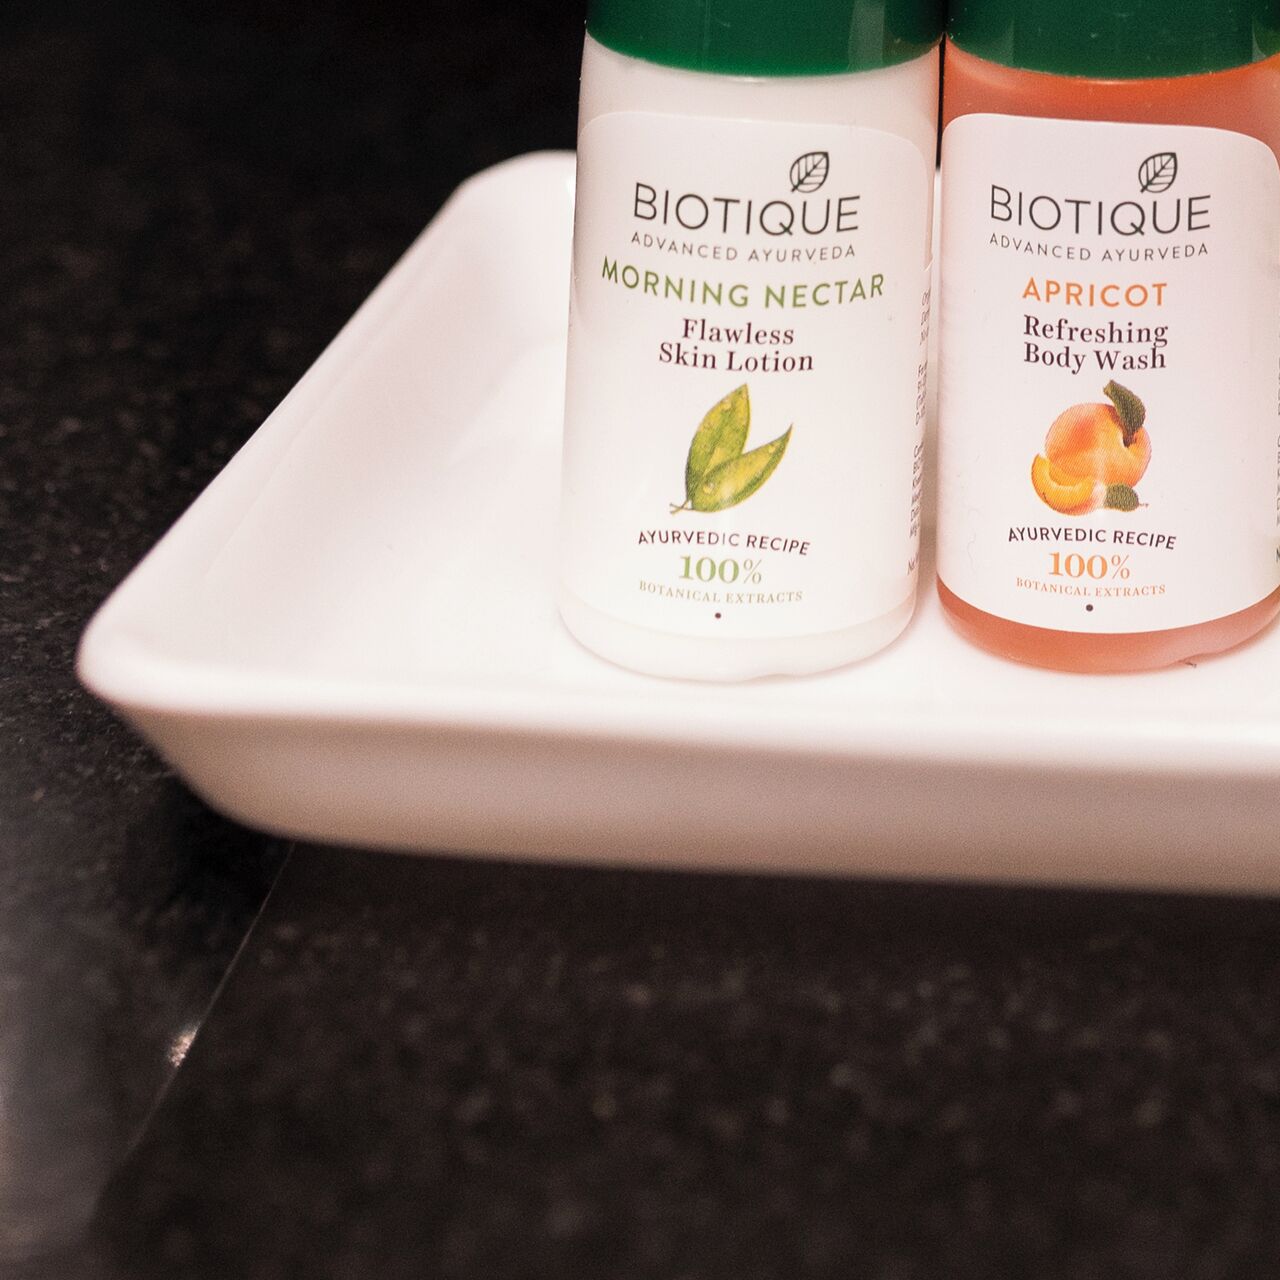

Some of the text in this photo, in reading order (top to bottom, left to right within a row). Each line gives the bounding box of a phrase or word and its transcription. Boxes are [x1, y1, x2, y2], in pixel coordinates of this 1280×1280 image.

[633, 182, 861, 237] BIOTIQUE
[990, 184, 1212, 237] BIOTIQUE
[631, 231, 856, 264] ADVANCED AYURVEDA
[989, 232, 1209, 263] ADVANCED AYURVEDA
[601, 255, 885, 310] MORNING NECTAR
[1021, 276, 1168, 308] APRICOT
[681, 317, 795, 346] Flawless
[1022, 314, 1169, 349] Refreshing
[658, 342, 815, 373] Skin Lotion
[1023, 341, 1167, 375] Body Wash
[638, 529, 811, 557] AYURVEDIC RECIPE
[1007, 526, 1178, 551] AYURVEDIC RECIPE
[677, 554, 763, 586] 100%
[1047, 550, 1131, 581] 100%
[638, 579, 804, 605] BOTANICAL EXTRACTS
[1015, 576, 1167, 599] BOTANICAL EXTRACTS
